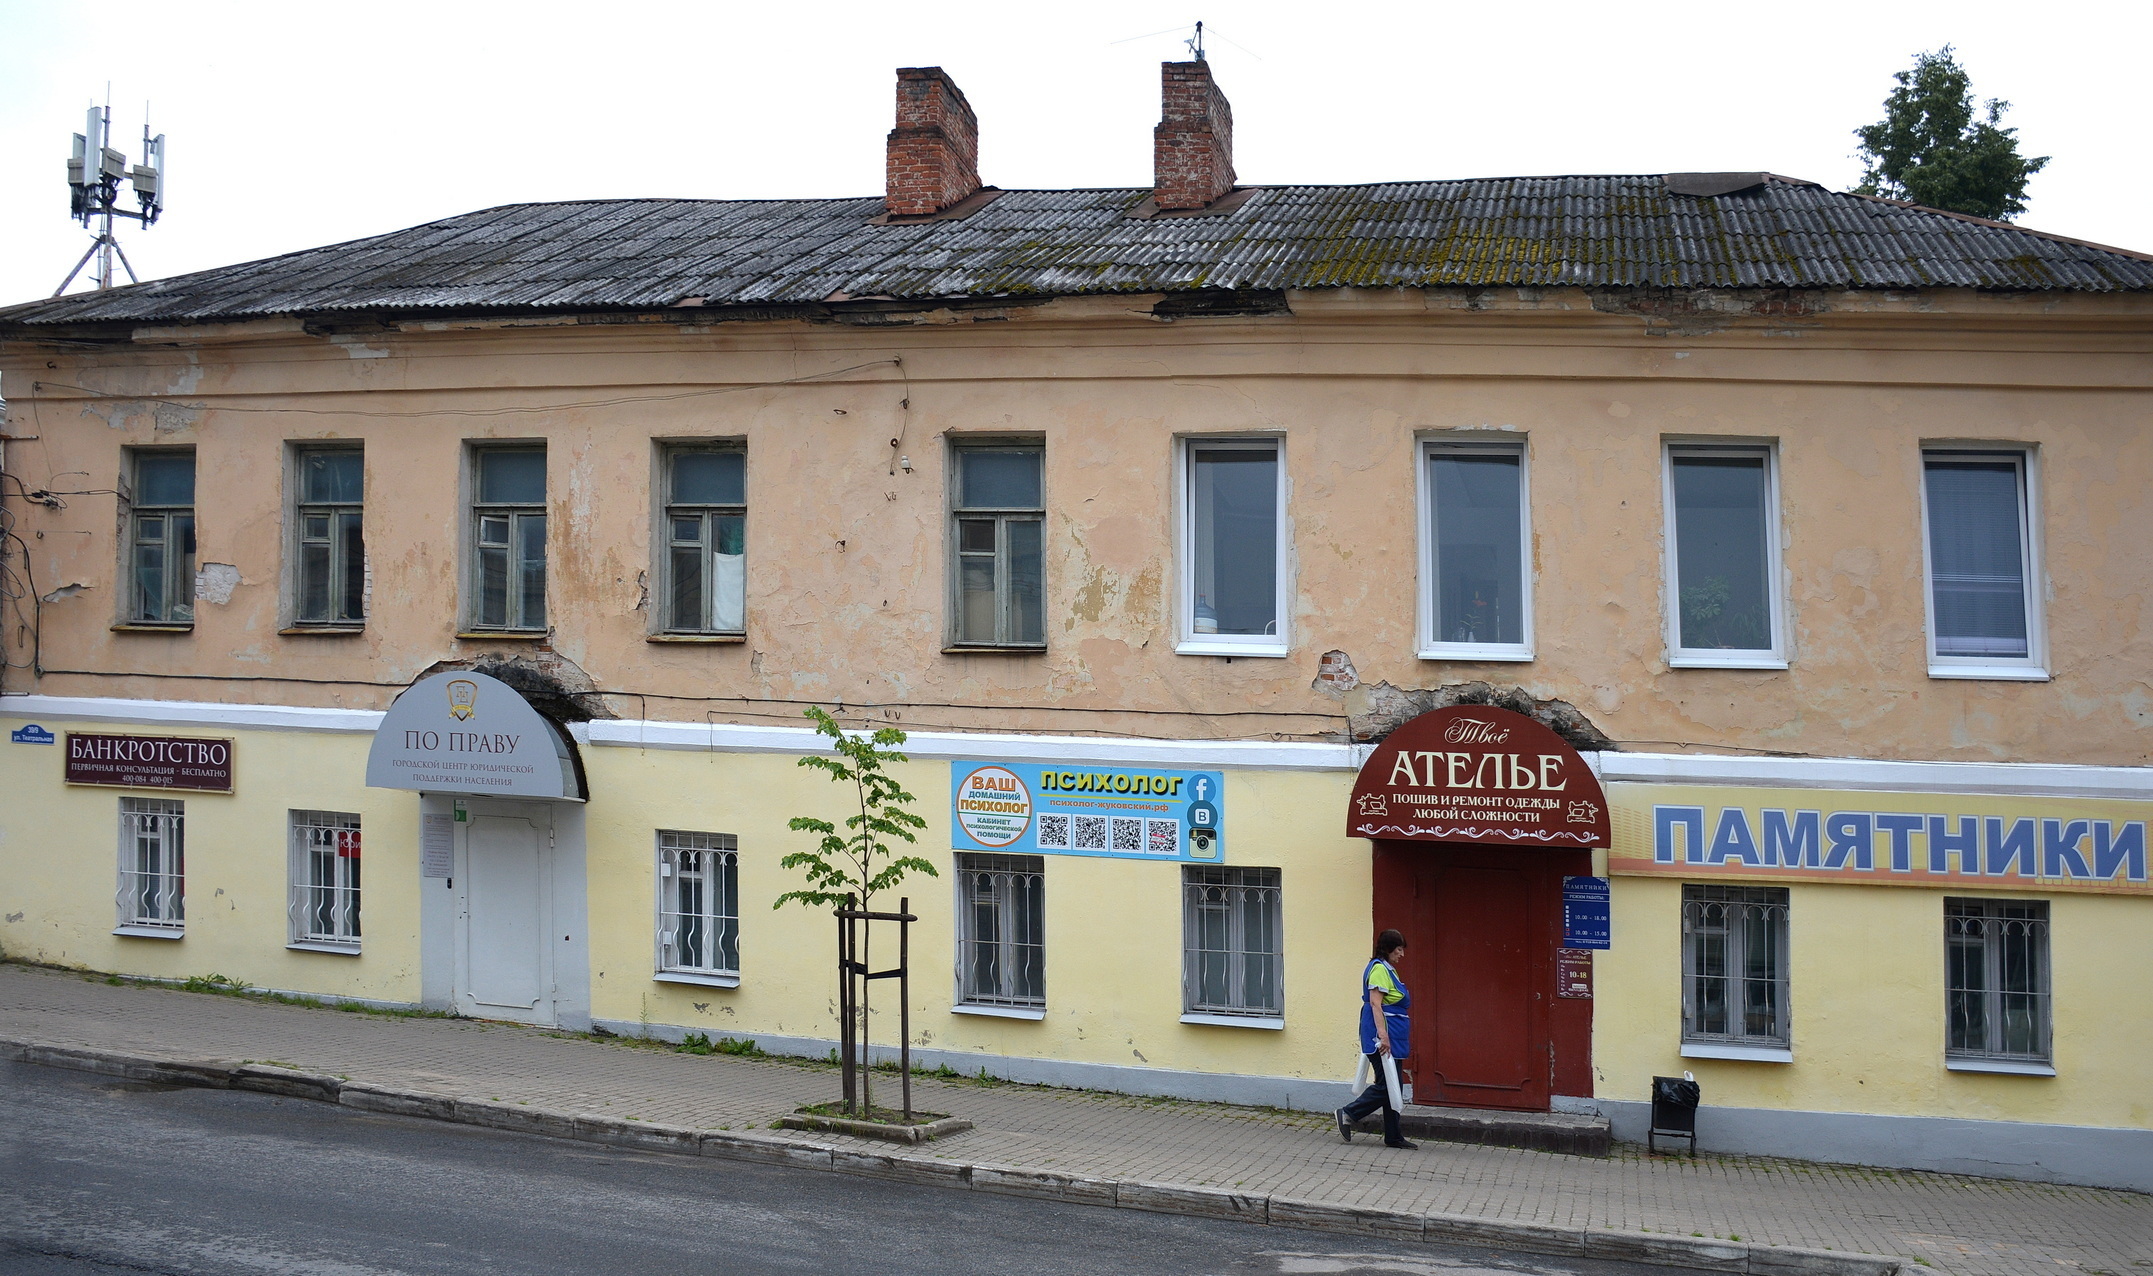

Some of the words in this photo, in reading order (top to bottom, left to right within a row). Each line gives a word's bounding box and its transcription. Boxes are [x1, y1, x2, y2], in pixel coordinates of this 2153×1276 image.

[1444, 717, 1510, 744] Твоё
[405, 731, 439, 750] ПО
[450, 732, 521, 754] ПРАВУ
[72, 738, 226, 765] БАНКРОТСТВО
[72, 763, 114, 772] ПЕРВИЧНАЯ
[116, 766, 174, 775] КОНСУЛЬТАЦИЯ
[182, 768, 226, 777] БЕСПЛАТНО
[392, 759, 440, 769] ГОРОДСКОЙ
[442, 762, 468, 771] ЦЕНТР
[470, 764, 534, 774] ЮРИДИЧЕСКОЙ
[1386, 751, 1568, 791] АТЕЛЬЕ
[413, 774, 462, 784] ПОДДЕРЖКИ
[464, 776, 512, 786] НАСЕЛЕНИЯ
[972, 776, 1016, 792] ВАШ
[968, 790, 1020, 800] ДОМАШНИЙ
[1392, 794, 1438, 804] ПОШИВ
[1441, 796, 1449, 805] И
[1452, 796, 1503, 807] РЕМОНТ
[1506, 797, 1560, 809] ОДЕЖДЫ
[961, 799, 1028, 813] ПСИХОЛОГ
[1050, 800, 1169, 812] психолог-жуковский.рф
[1413, 807, 1458, 820] ЛЮБОЙ
[1461, 810, 1540, 822] СЛОЖНОСТИ
[977, 831, 1011, 839] ПОМОЩИ
[1652, 804, 2147, 882] ПАМЯТНИКИ
